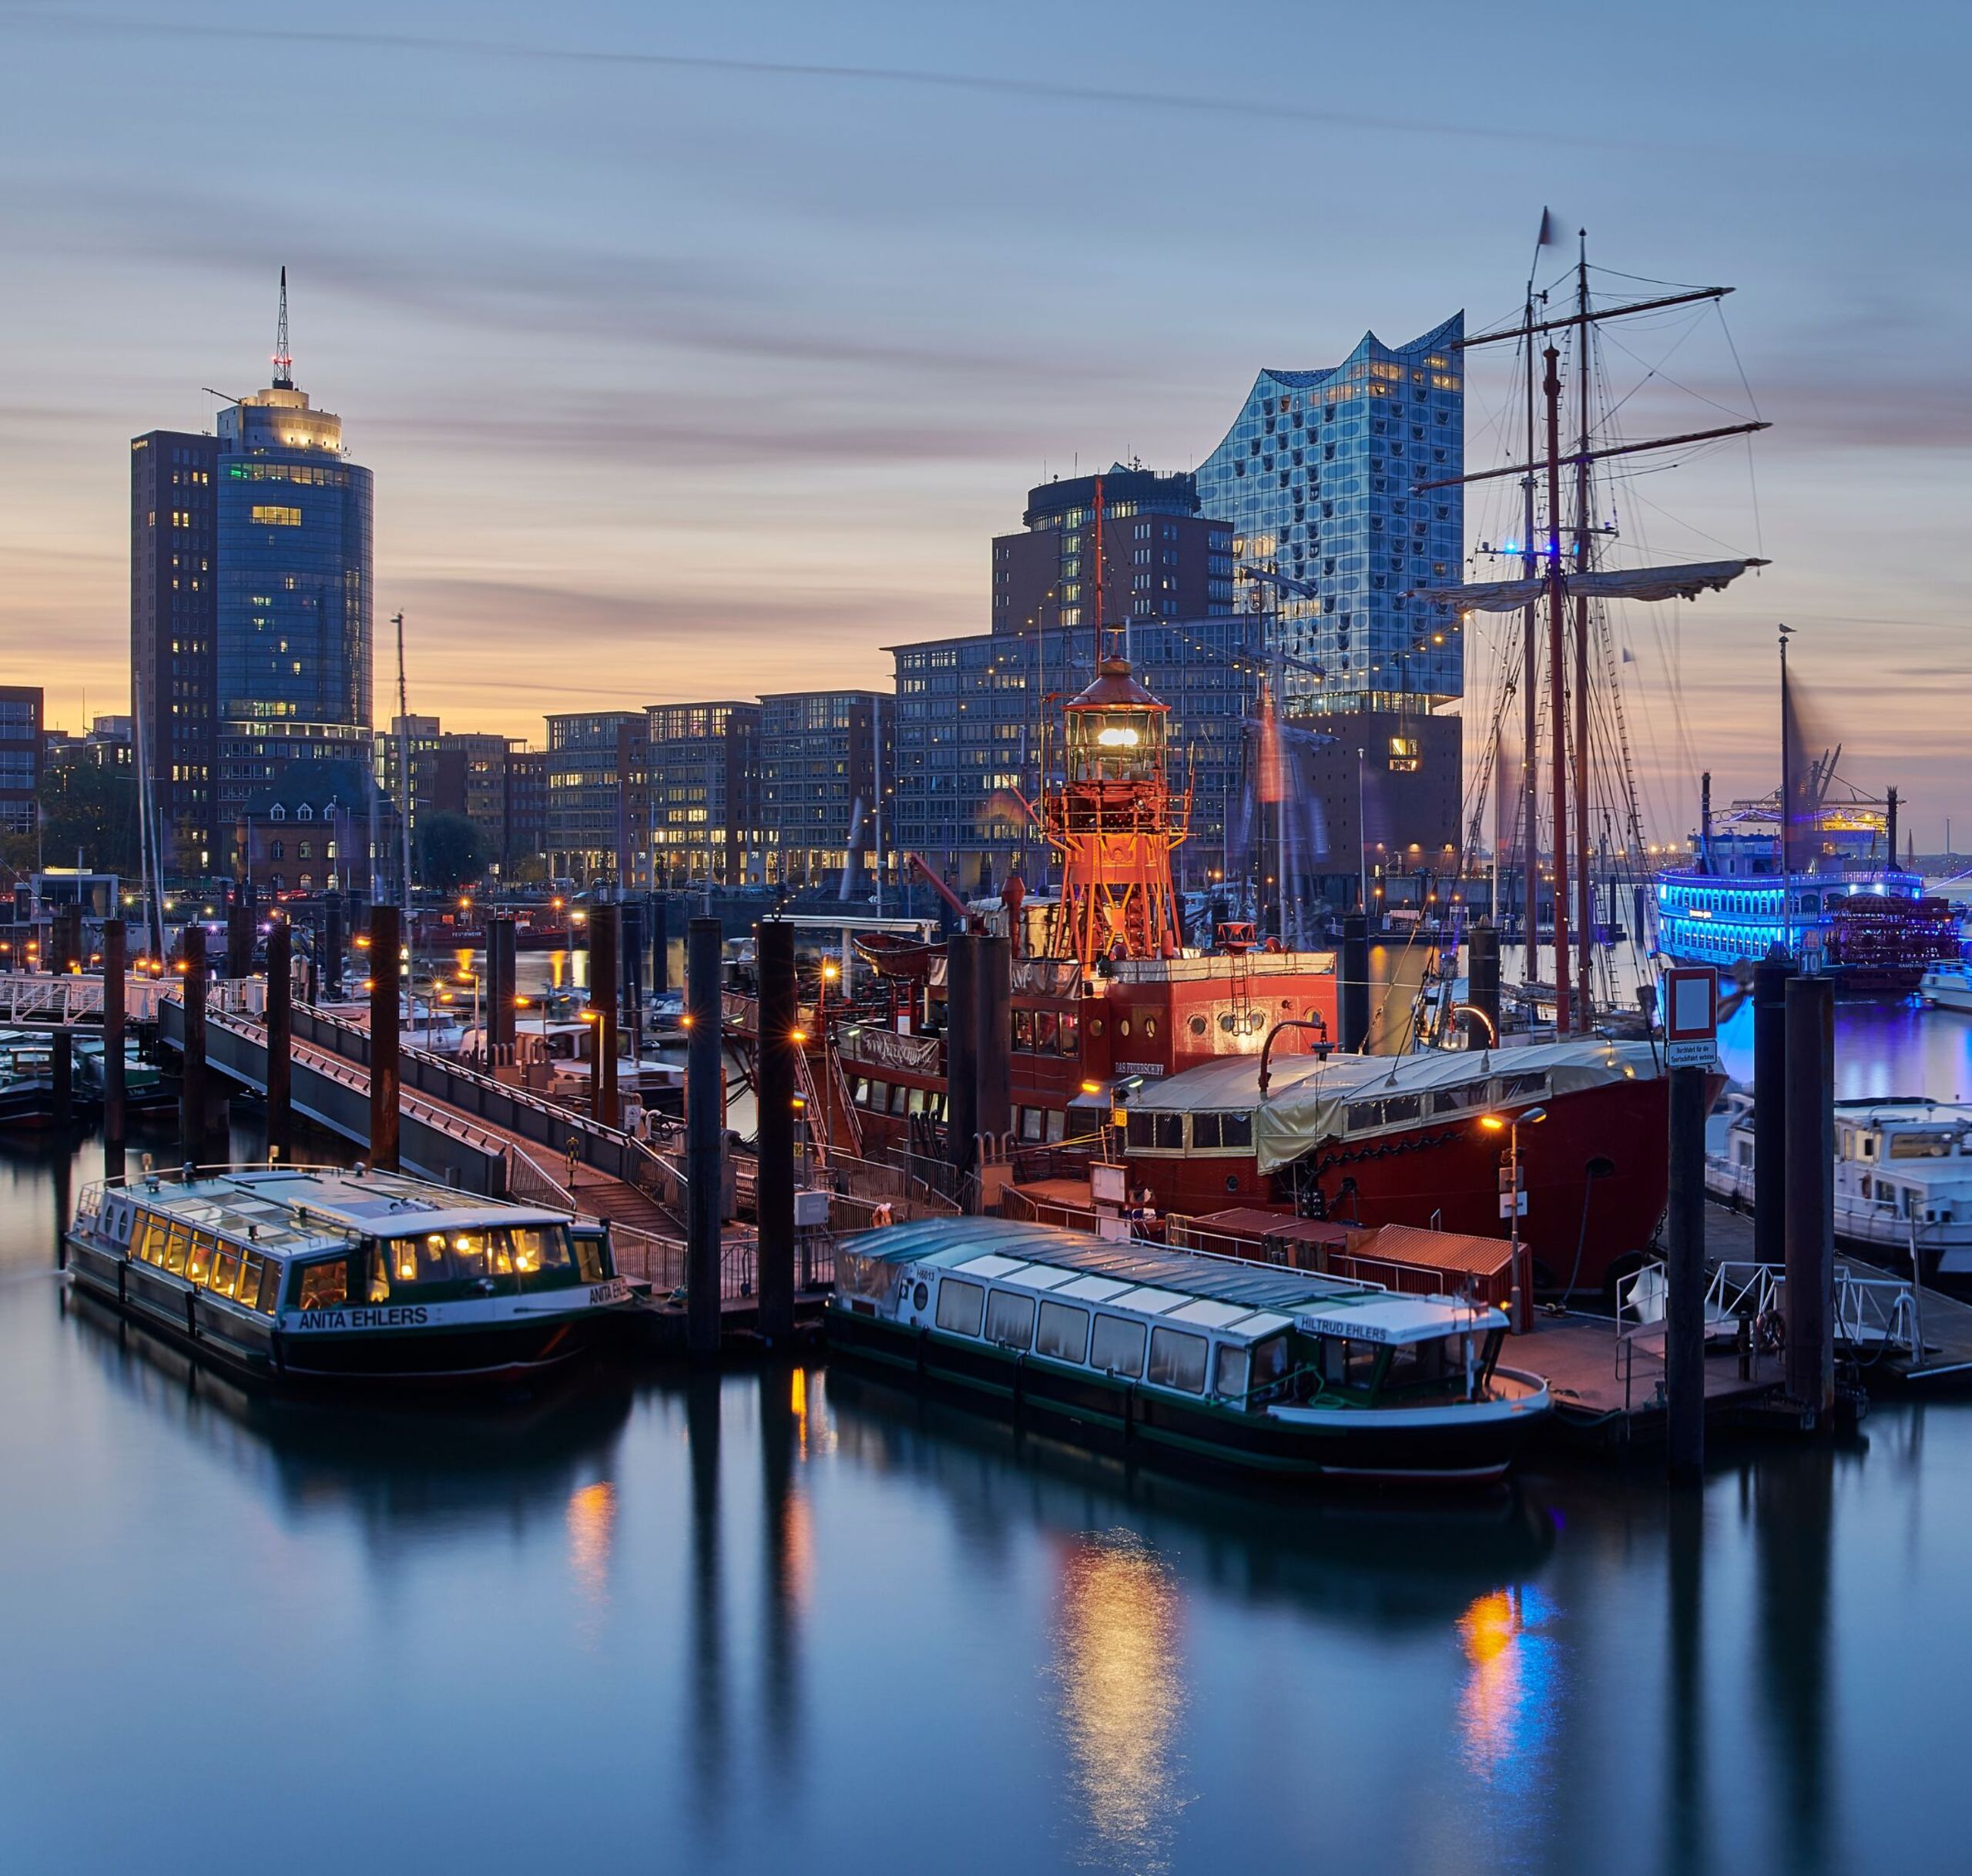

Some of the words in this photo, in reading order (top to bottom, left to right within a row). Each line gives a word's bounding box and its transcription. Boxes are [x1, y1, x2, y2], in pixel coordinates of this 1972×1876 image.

[1802, 954, 1818, 972] 10
[1115, 1062, 1125, 1073] DAS
[1127, 1063, 1164, 1075] FEUERSCHIFF
[590, 1285, 612, 1305] ANITA
[299, 1312, 346, 1330] ANITA
[352, 1307, 428, 1328] EHLERS
[1301, 1317, 1343, 1334] HILTRUD
[1346, 1323, 1387, 1341] EHLERS
